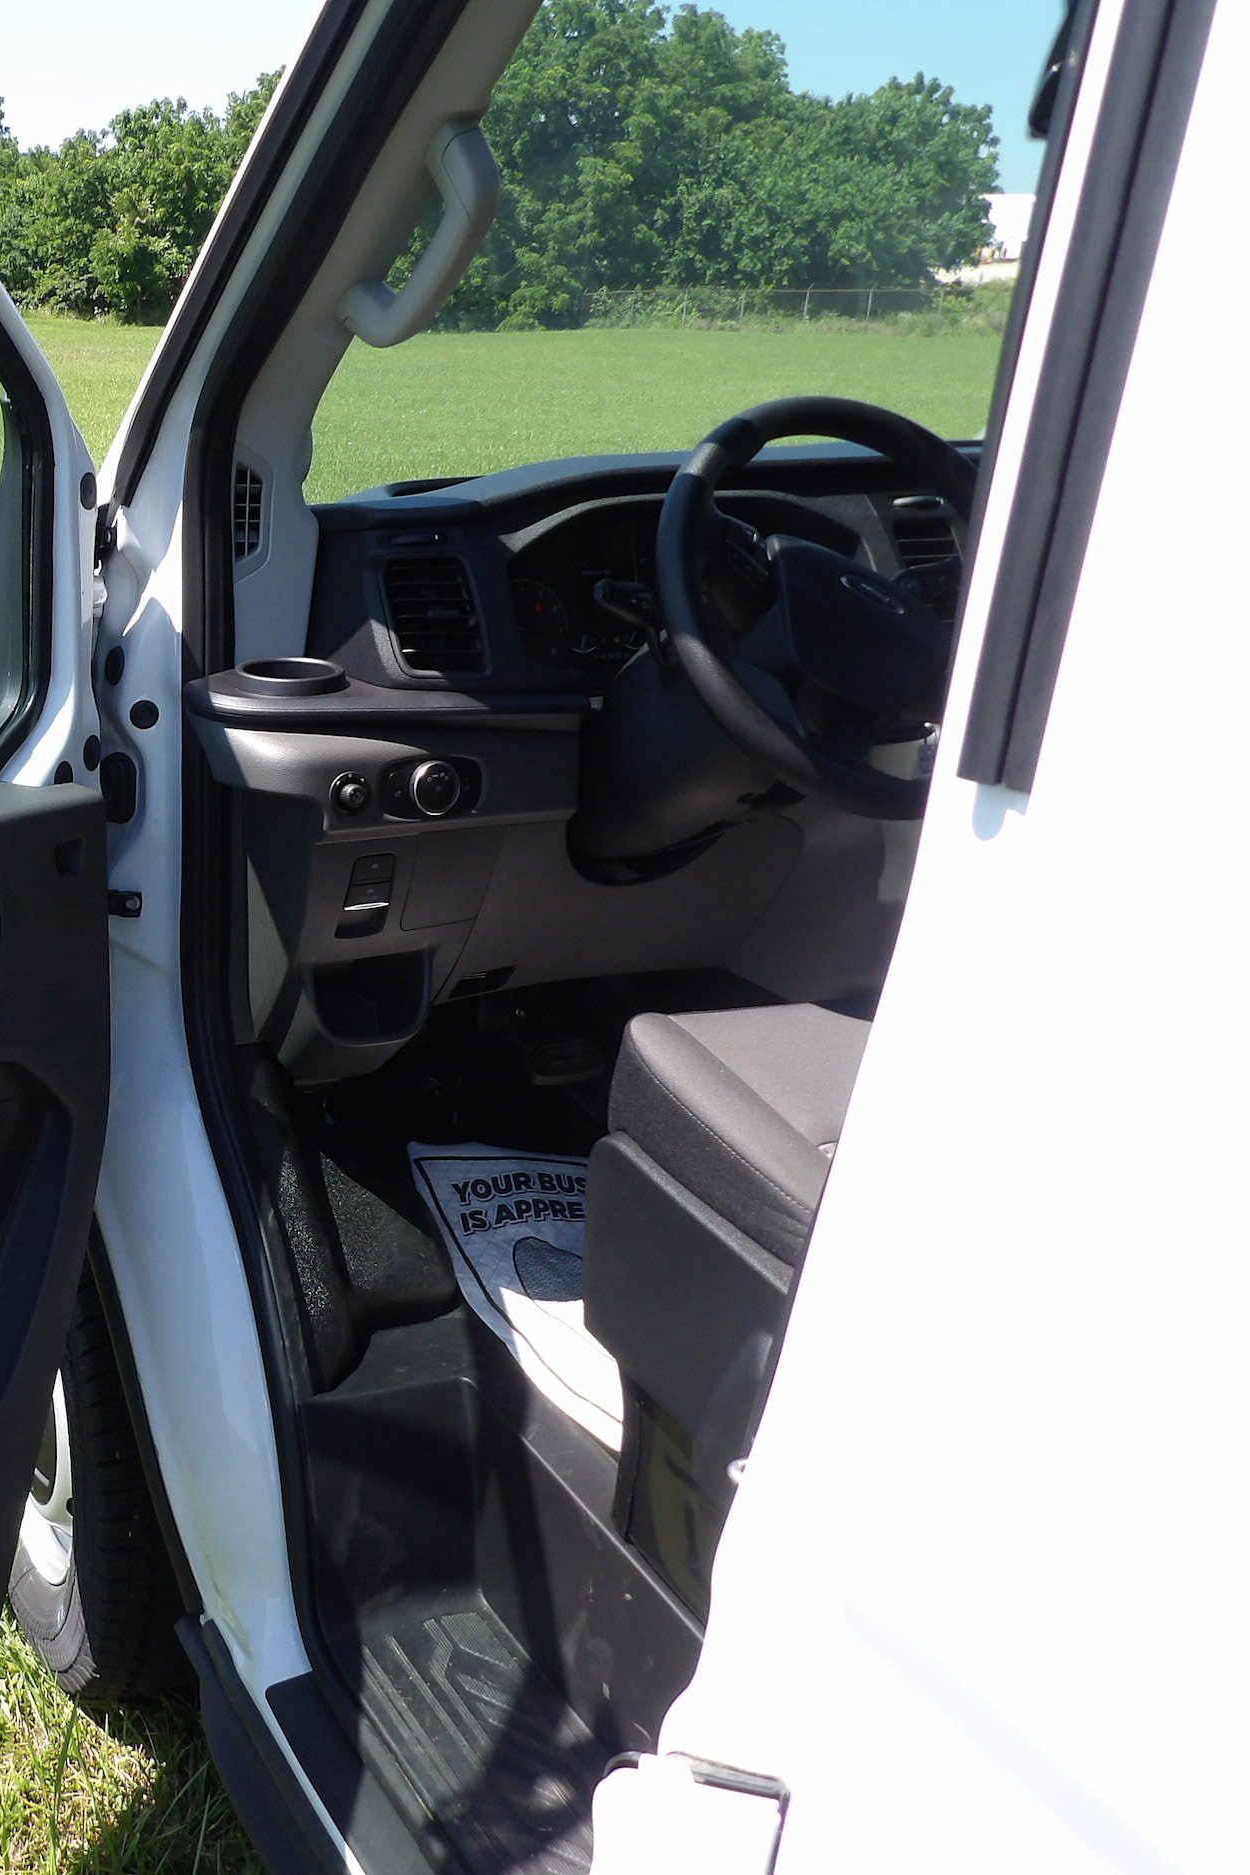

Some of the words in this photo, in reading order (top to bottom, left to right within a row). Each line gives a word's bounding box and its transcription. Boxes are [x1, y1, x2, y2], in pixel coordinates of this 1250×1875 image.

[451, 1171, 534, 1204] YOUR
[460, 1208, 490, 1236] IS
[493, 1198, 586, 1227] APPRE
